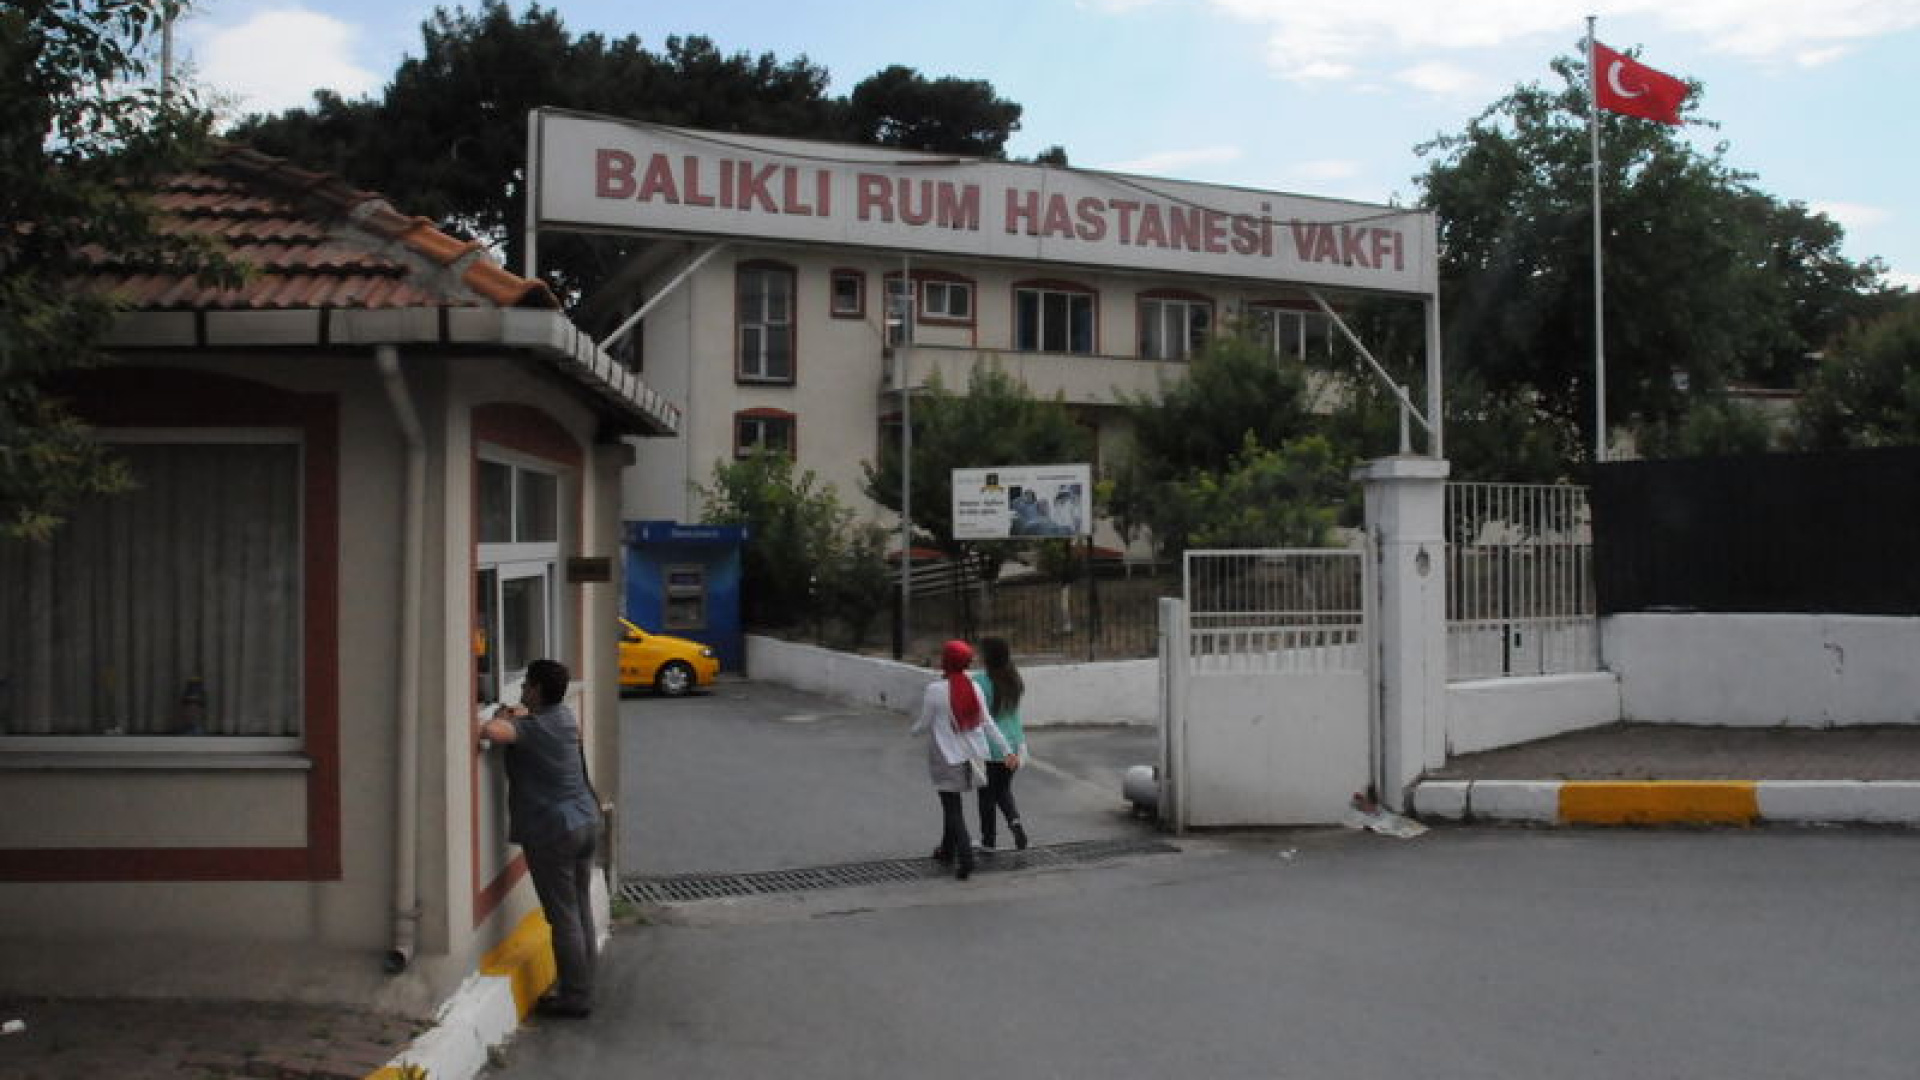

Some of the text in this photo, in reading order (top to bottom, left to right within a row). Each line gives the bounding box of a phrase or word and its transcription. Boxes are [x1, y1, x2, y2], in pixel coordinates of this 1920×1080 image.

[595, 148, 1405, 271] BALIKLI RUM HASTANESİ VAKFI
